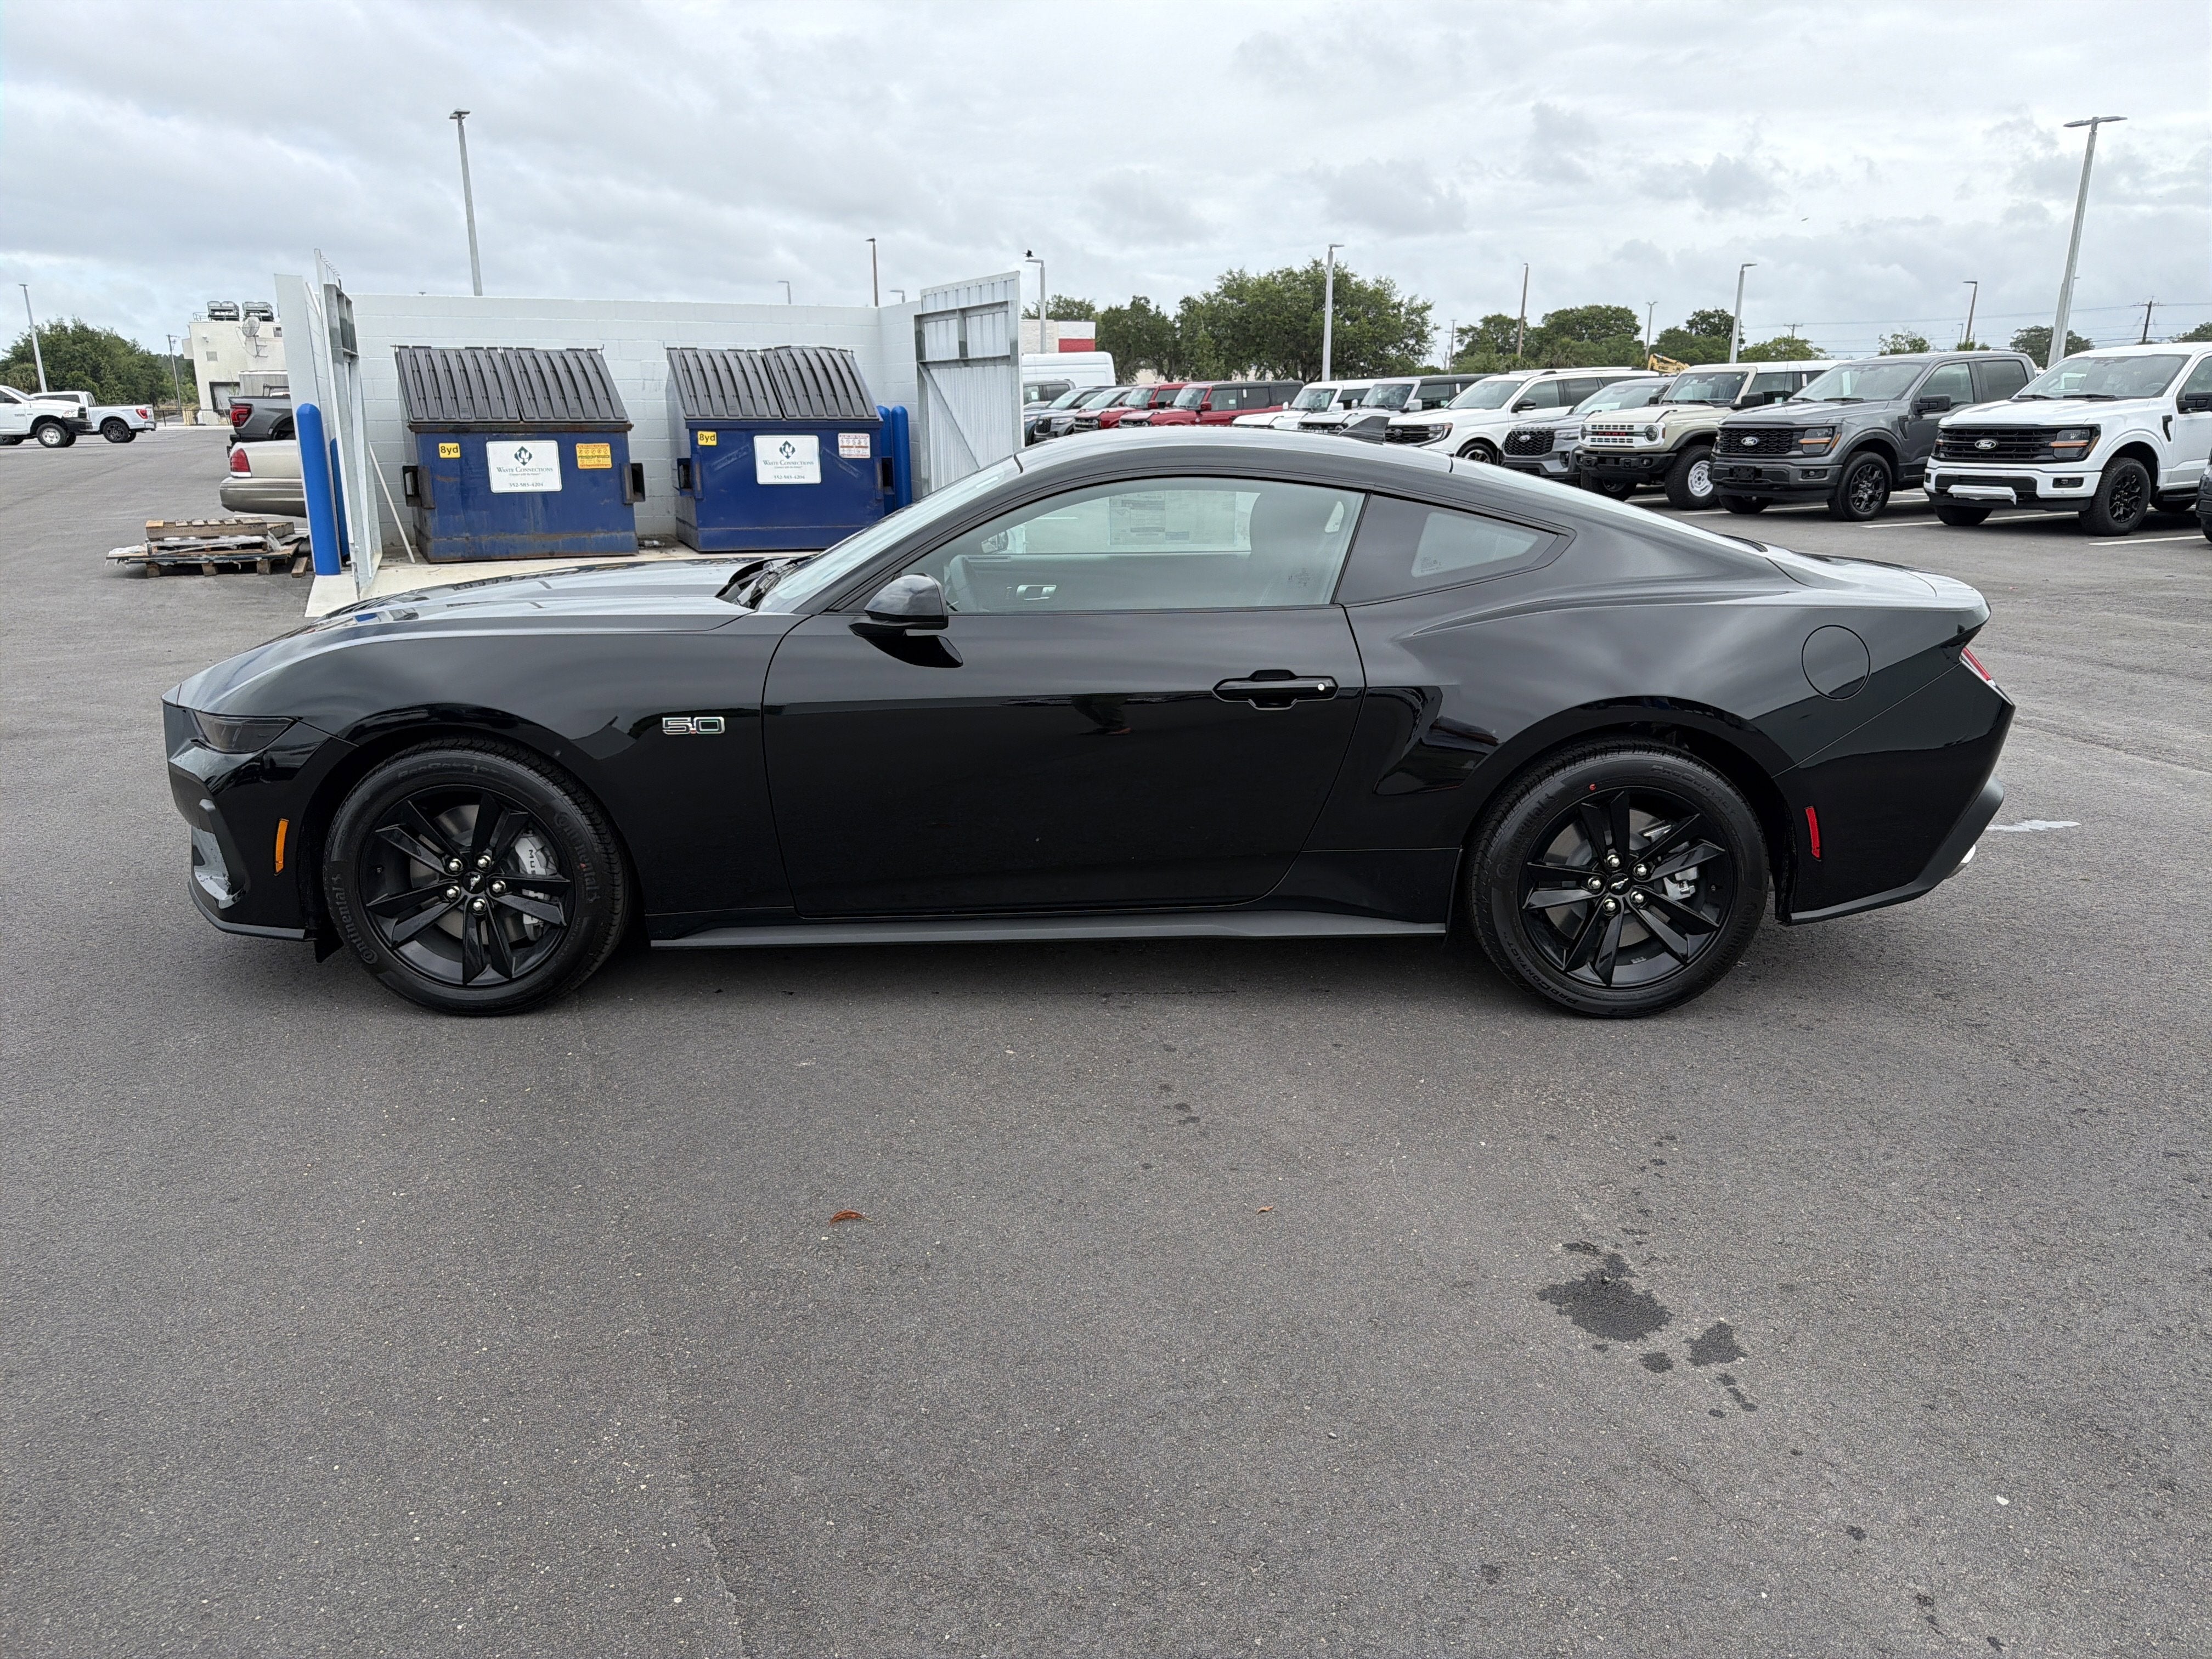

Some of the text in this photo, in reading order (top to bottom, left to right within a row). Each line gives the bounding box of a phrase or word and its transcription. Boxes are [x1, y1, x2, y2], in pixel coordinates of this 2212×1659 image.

[699, 433, 715, 443] 8yd
[441, 445, 459, 455] 8yd
[662, 716, 725, 735] 5.0
